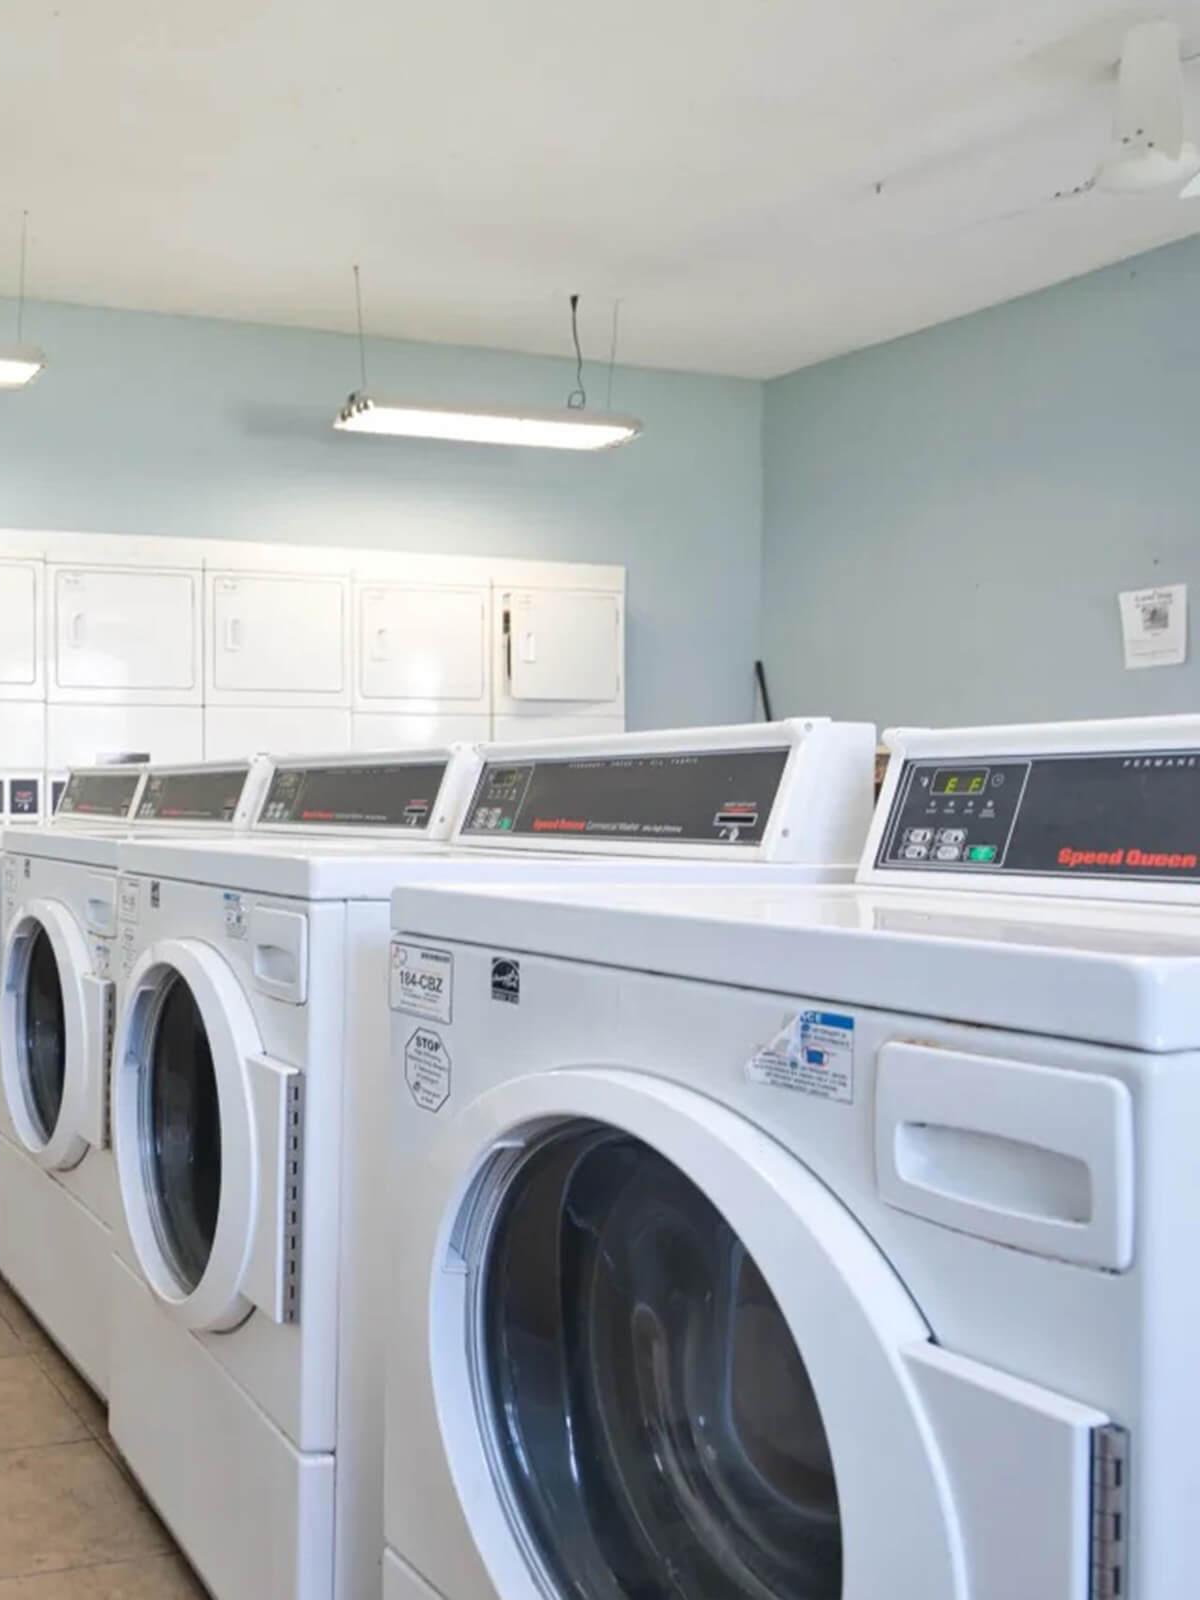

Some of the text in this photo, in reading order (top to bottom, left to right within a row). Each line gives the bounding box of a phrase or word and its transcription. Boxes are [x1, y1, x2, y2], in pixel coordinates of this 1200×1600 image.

[1058, 847, 1196, 868] Speed Queen
[416, 1035, 441, 1051] STOP
